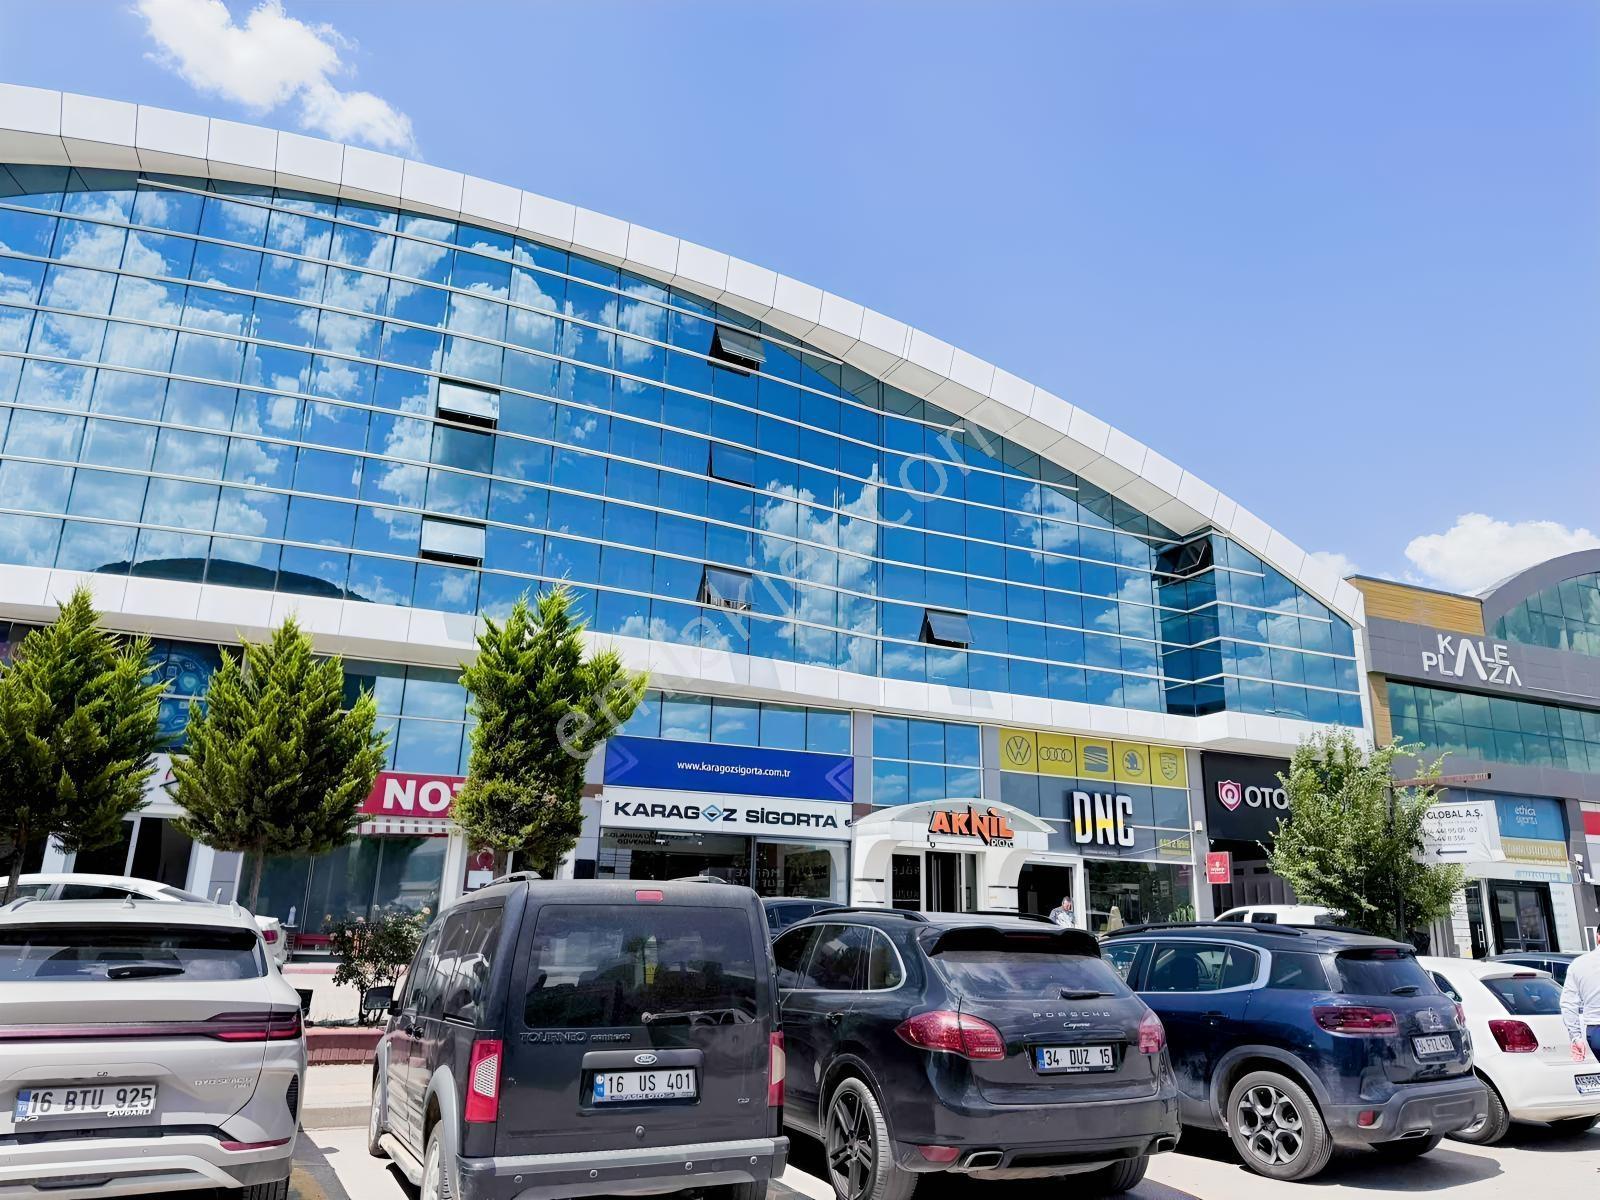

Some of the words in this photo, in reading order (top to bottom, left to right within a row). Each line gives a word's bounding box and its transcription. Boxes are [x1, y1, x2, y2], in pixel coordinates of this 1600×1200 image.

[1437, 634, 1510, 674] KALE
[677, 761, 791, 778] www.karagozsigorta.com.tr
[745, 807, 838, 828] SİGORTA
[1072, 791, 1135, 847] DNC
[1426, 809, 1463, 820] GLOBAL
[520, 1032, 586, 1043] TOURNEO
[1045, 1050, 1060, 1066] 34
[1070, 1049, 1090, 1065] DUZ
[1100, 1048, 1110, 1064] 15
[609, 1076, 624, 1094] 16
[639, 1075, 656, 1091] US
[667, 1073, 691, 1090] 401
[31, 1091, 54, 1113] 16
[63, 1089, 105, 1112] BTU
[115, 1087, 153, 1109] 925
